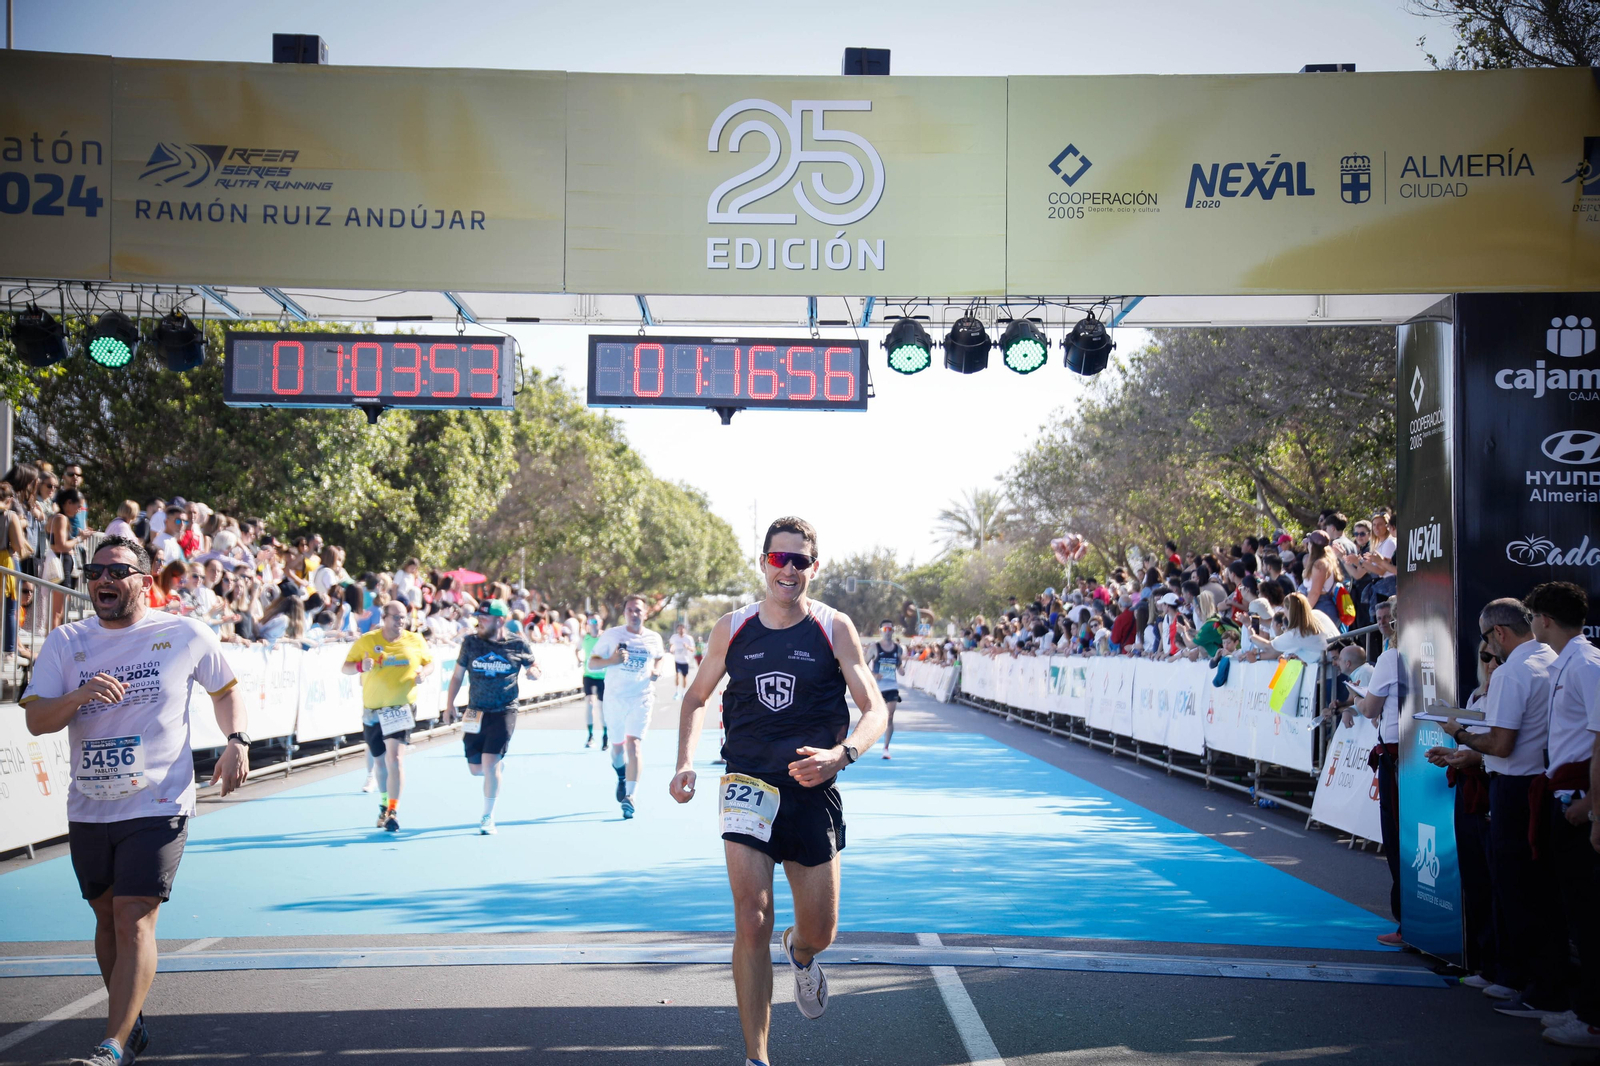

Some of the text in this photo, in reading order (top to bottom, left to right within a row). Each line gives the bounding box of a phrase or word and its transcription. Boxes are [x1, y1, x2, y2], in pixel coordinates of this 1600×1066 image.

[2, 130, 102, 165] atón
[227, 148, 300, 164] RFEA
[707, 98, 886, 225] 25
[1400, 147, 1535, 179] ALMERÍA
[221, 165, 293, 179] SERIES
[214, 178, 334, 192] RUTA RUNNING
[1400, 182, 1468, 198] CIUDAD
[0, 171, 104, 218] 024
[1048, 190, 1158, 205] COOPERACIÓN
[1048, 206, 1085, 219] 2005
[1195, 200, 1221, 209] 2020
[135, 197, 486, 231] RAMÓN RUIZ ANDÚJAR
[706, 230, 886, 271] EDICIÓN
[633, 343, 855, 401] 01:16:56
[1569, 391, 1600, 401] CAJA
[1409, 434, 1423, 450] 2005
[114, 660, 160, 673] Maratón
[126, 668, 160, 681] 2024
[127, 680, 160, 689] NDÚJAR
[82, 747, 136, 770] 5456
[724, 783, 765, 807] 521
